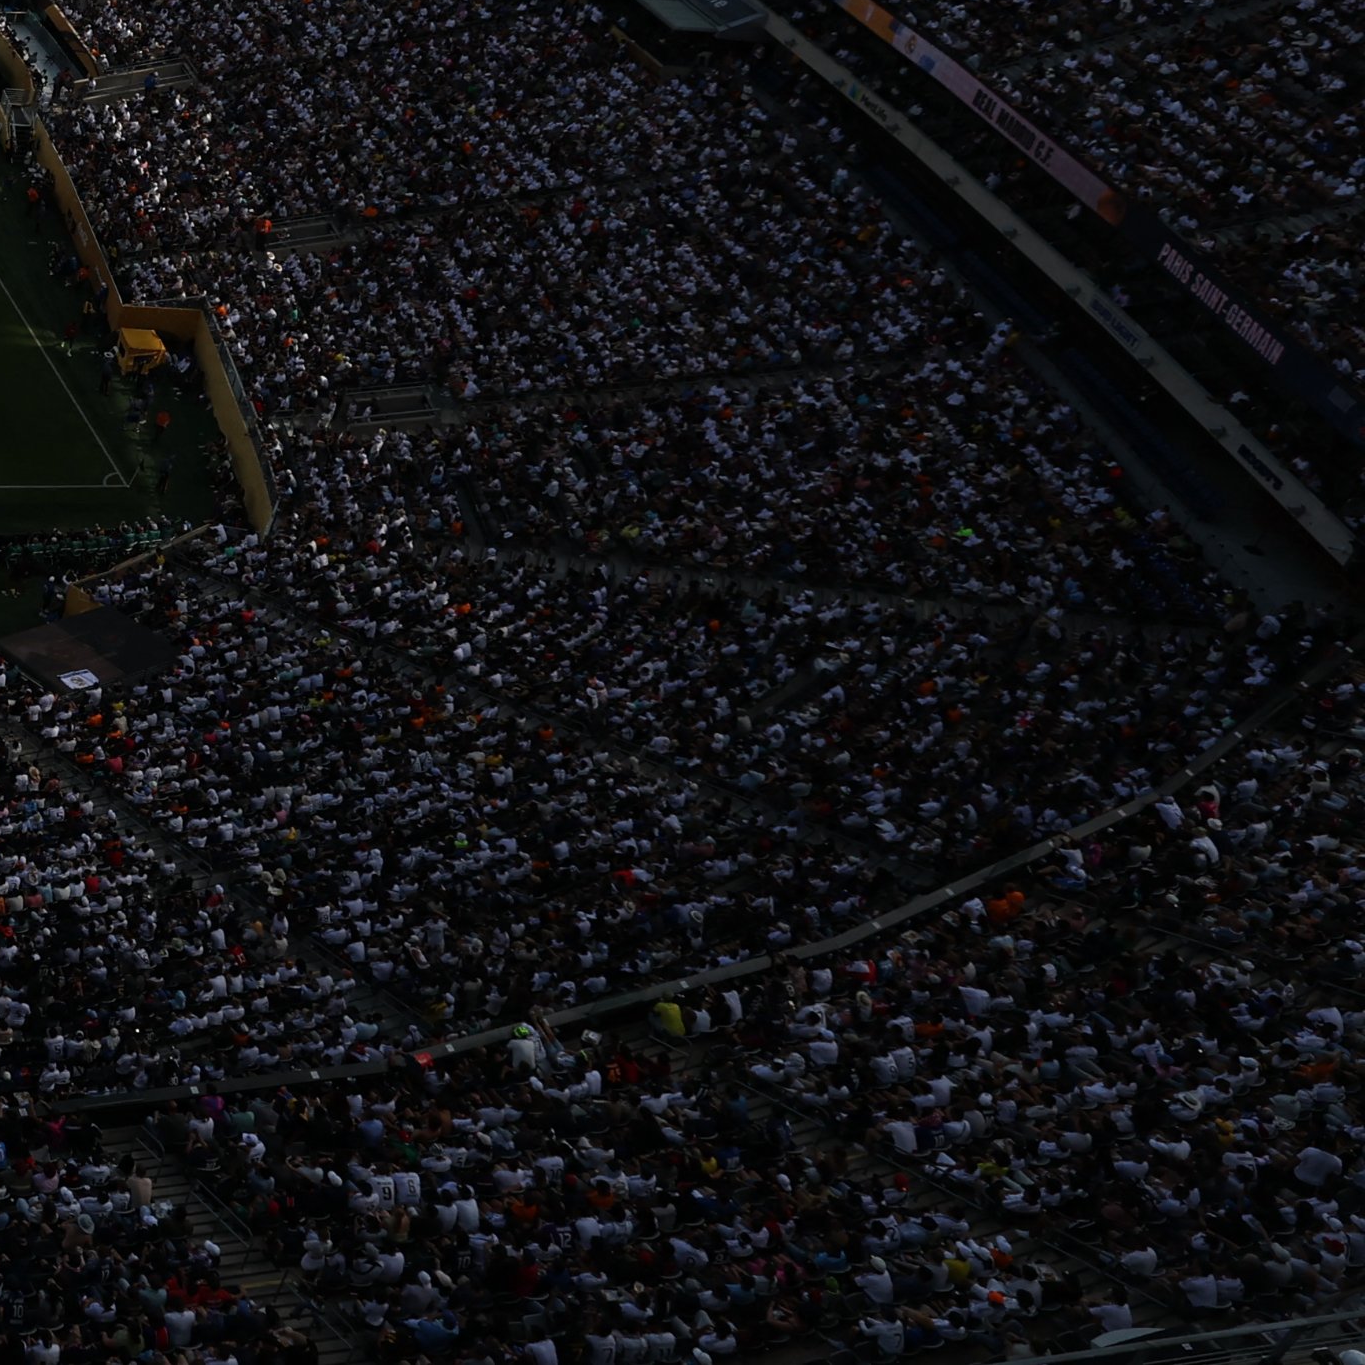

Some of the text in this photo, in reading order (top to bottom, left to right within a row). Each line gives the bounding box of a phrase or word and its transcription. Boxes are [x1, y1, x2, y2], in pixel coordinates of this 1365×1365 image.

[972, 89, 998, 120] REAL
[996, 107, 1036, 150] MADRID
[1157, 242, 1286, 365] PARIS SAINT-GERMAIN
